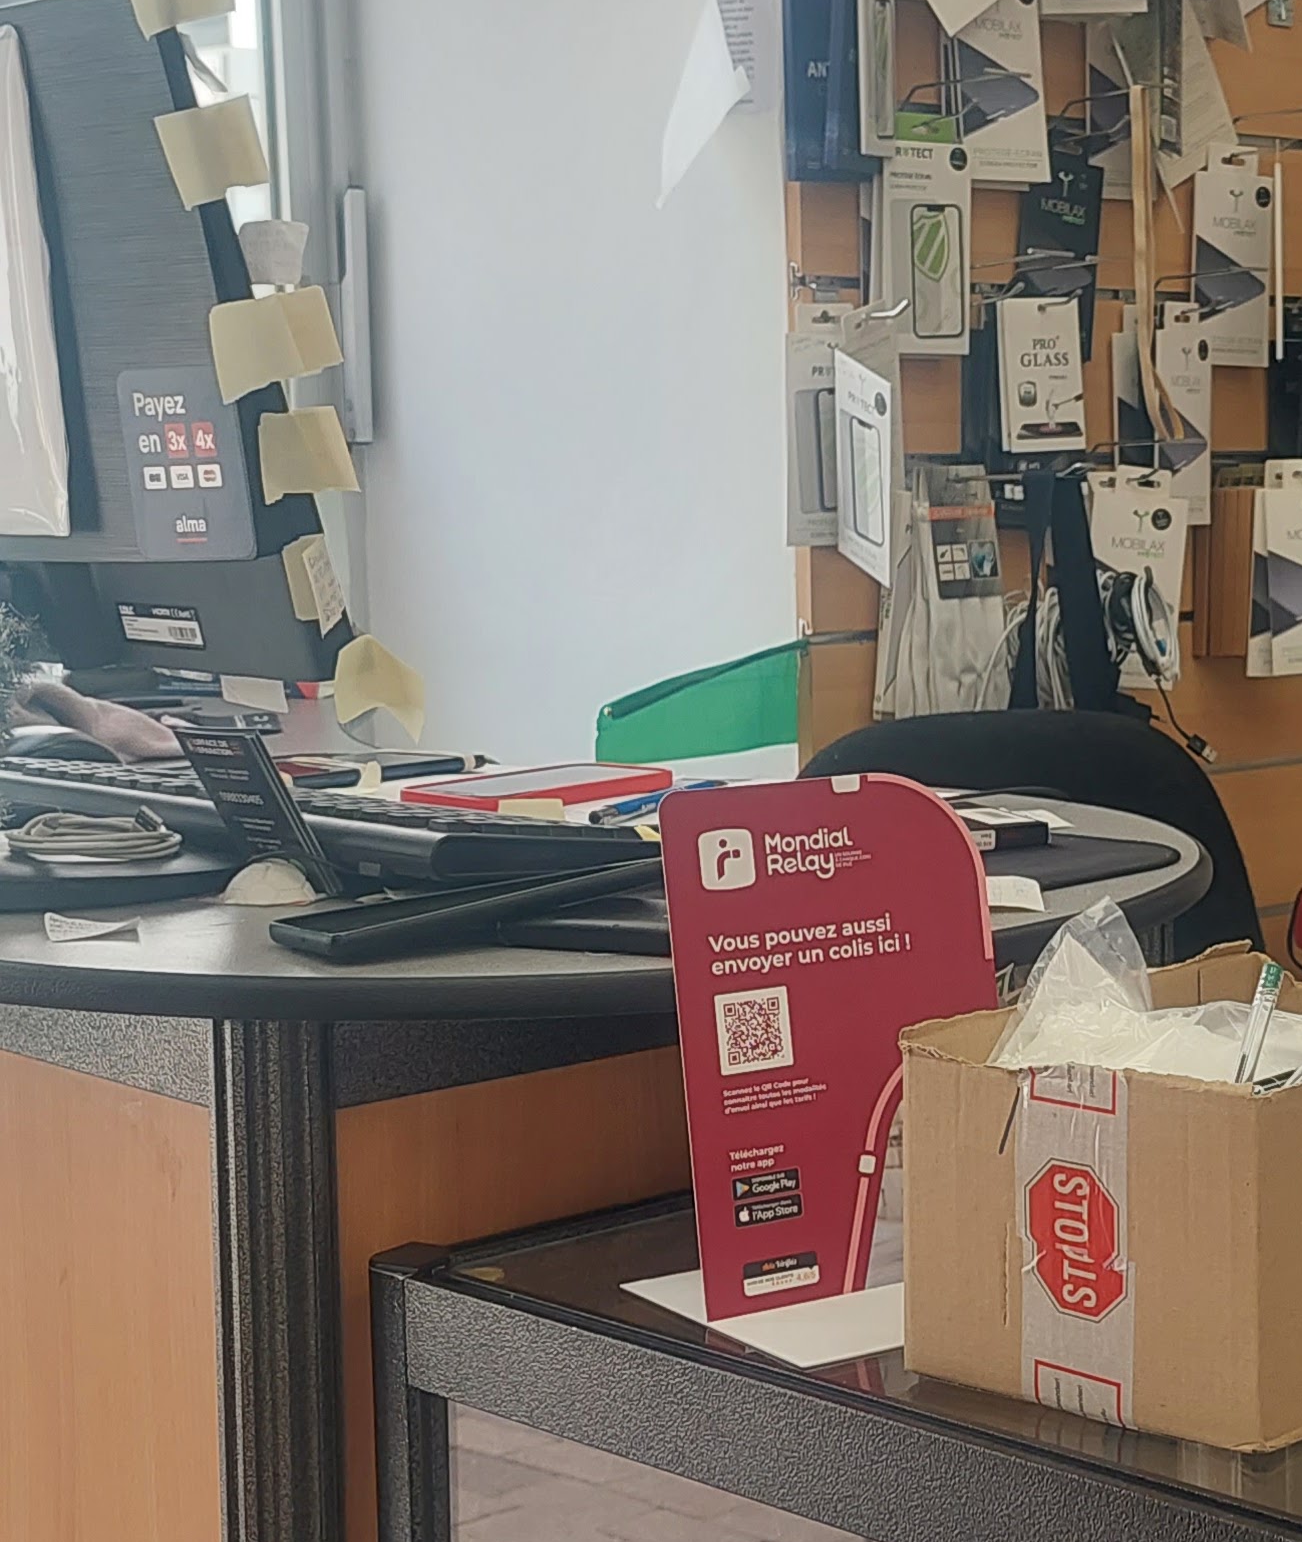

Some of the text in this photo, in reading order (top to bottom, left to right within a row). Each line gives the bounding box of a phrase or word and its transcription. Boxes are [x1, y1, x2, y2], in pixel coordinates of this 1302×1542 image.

[1020, 352, 1070, 368] GLASS
[132, 392, 187, 421] Payez
[138, 429, 216, 454] en 3x 4x
[175, 516, 207, 533] alma
[1111, 536, 1165, 552] MOBILAX
[764, 826, 854, 854] Mondial
[766, 851, 836, 880] Relay
[708, 912, 893, 954] Vous pouvez aussi
[710, 933, 912, 976] envoyer un colis ici !
[722, 1086, 753, 1098] Scannez
[773, 1080, 792, 1090] Code
[792, 1077, 809, 1088] pour
[758, 1090, 781, 1100] toutes
[751, 1099, 768, 1110] ainsi
[729, 1144, 785, 1162] Téléchargez
[730, 1157, 775, 1173] notre app
[752, 1178, 797, 1195] Google Play
[775, 1204, 799, 1217] Store
